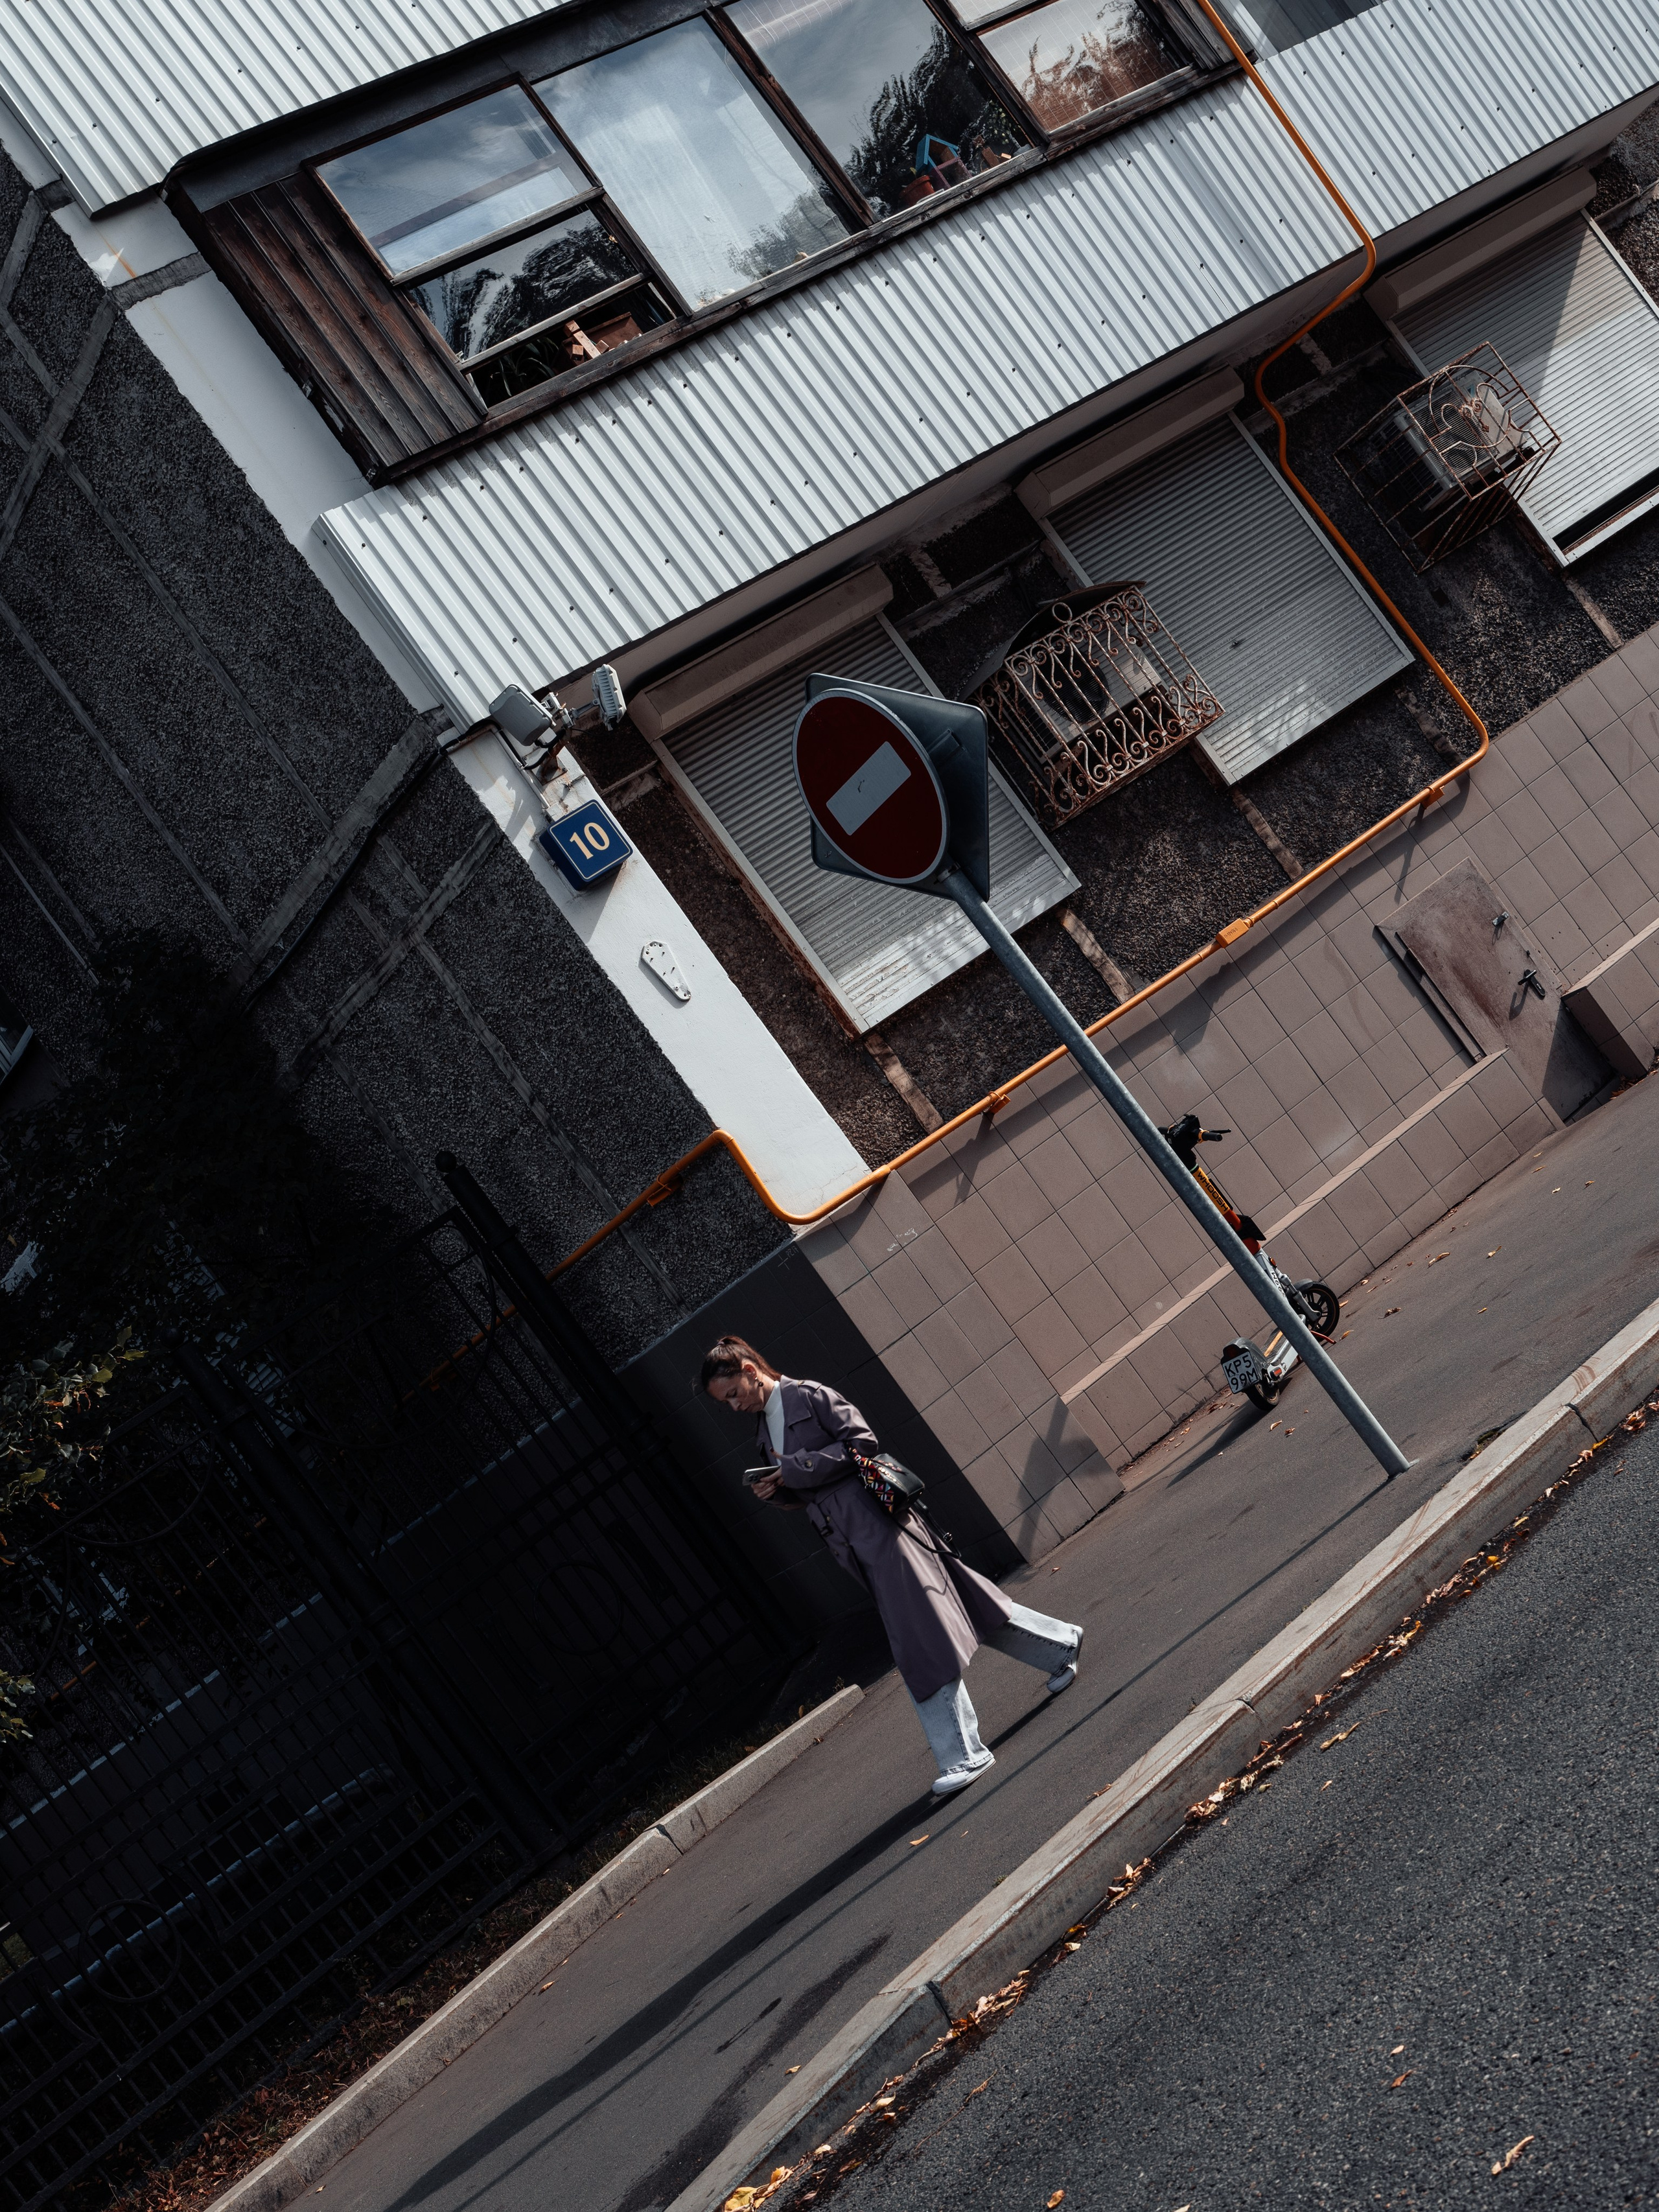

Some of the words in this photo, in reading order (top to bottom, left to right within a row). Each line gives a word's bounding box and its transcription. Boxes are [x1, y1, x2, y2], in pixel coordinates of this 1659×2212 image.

[570, 822, 610, 859] 10
[1198, 1171, 1228, 1211] WHOOSH
[1231, 1368, 1259, 1390] 99M
